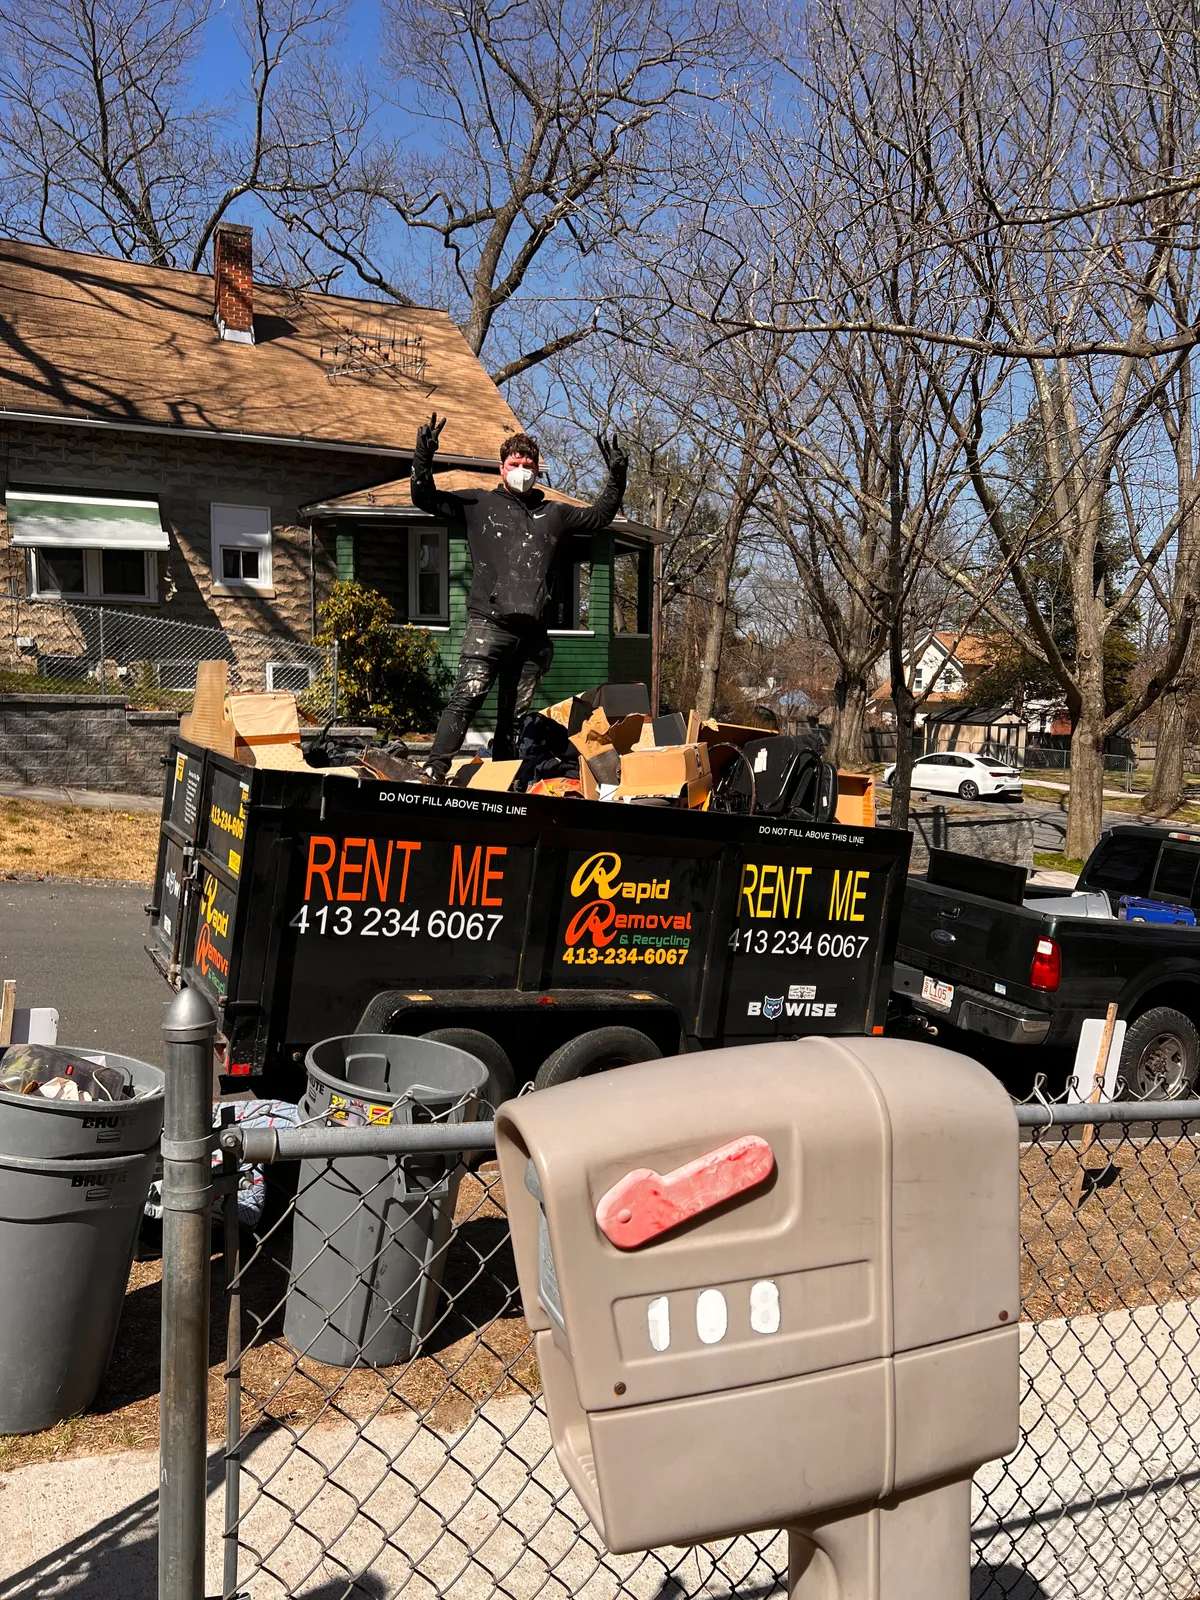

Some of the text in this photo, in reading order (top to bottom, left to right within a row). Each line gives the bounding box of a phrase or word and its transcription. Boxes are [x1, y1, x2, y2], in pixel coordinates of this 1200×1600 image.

[379, 791, 528, 816] DO NOT FILL ABOVE THIS LINE
[758, 825, 865, 845] DO NOT FILL ABOVE THIS LINE
[304, 835, 508, 907] RENT ME
[570, 851, 671, 904] Rapid
[736, 863, 871, 922] RENT ME
[288, 904, 504, 941] 413 234 6067
[564, 899, 692, 948] Removal
[562, 947, 689, 965] 413-234-6067
[619, 934, 690, 949] & Recycling
[727, 928, 870, 959] 413 234 6067
[82, 1114, 138, 1129] BRUTE
[71, 1171, 128, 1187] BRUTE
[646, 1279, 782, 1353] 108
